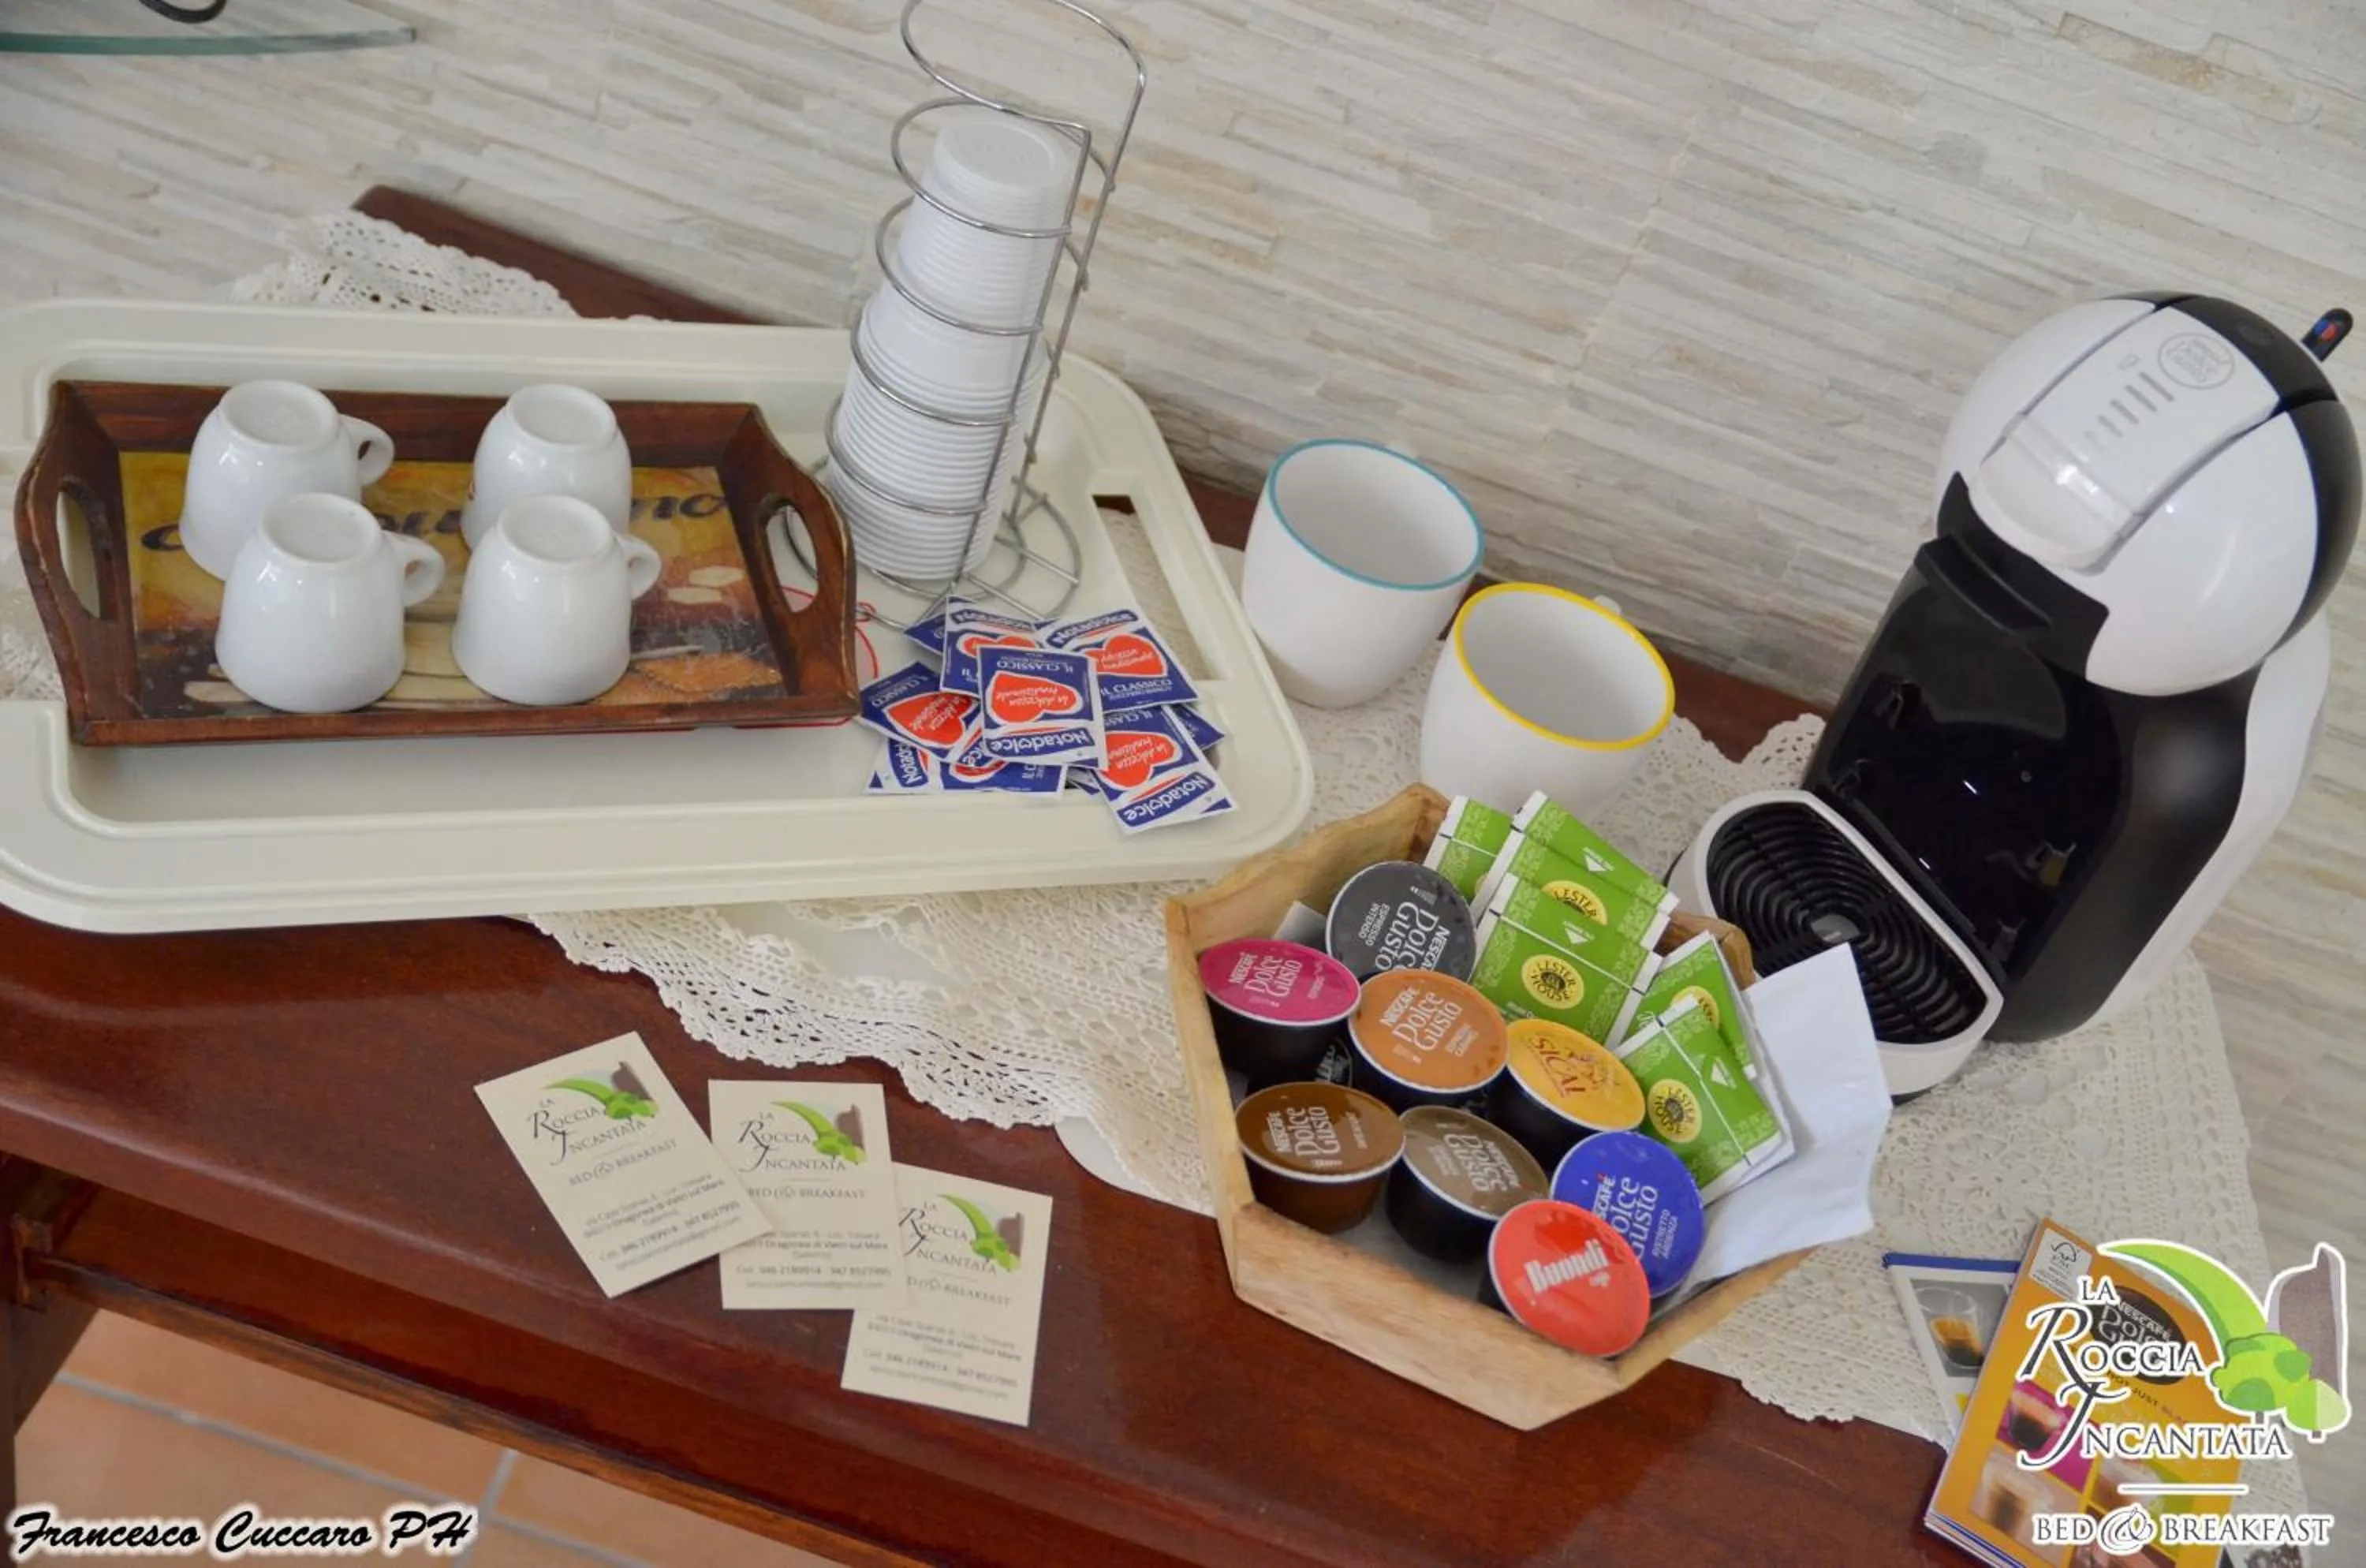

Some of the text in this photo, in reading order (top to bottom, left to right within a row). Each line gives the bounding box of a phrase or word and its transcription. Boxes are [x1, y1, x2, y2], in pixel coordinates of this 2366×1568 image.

[996, 660, 1060, 672] CLASSICO
[1113, 679, 1173, 693] CLASSICO
[990, 730, 1088, 753] Notadolce
[1123, 775, 1209, 821] Notadolce
[1358, 902, 1382, 939] INTENSO
[1365, 903, 1390, 946] ESPRESSO
[1375, 902, 1419, 970] Gusto
[1394, 909, 1440, 969] Dolc
[1420, 925, 1451, 970] NESCA
[1244, 955, 1283, 993] Dolce
[1266, 960, 1303, 997] Gusto
[1531, 974, 1570, 1001] HOUSE
[1537, 960, 1577, 987] LESTER
[1392, 991, 1445, 1042] Dolce
[1415, 1002, 1463, 1051] Gusto
[526, 1106, 600, 1139] ROCCIA
[738, 1120, 812, 1148] ROCCIA
[1286, 1107, 1319, 1156] Dolce
[1308, 1107, 1341, 1154] Gusto
[569, 1170, 592, 1186] BED
[615, 1138, 678, 1168] BREAKFAST
[738, 1145, 846, 1173] INCANTATA
[1443, 1133, 1490, 1192] Gusto
[1464, 1134, 1508, 1192] Dolce
[748, 1187, 772, 1198] BED
[799, 1187, 865, 1199] BREAKFAST
[1611, 1176, 1640, 1234] olce
[898, 1207, 968, 1241] ROCCIA
[945, 1284, 1010, 1308] BREAKFAST
